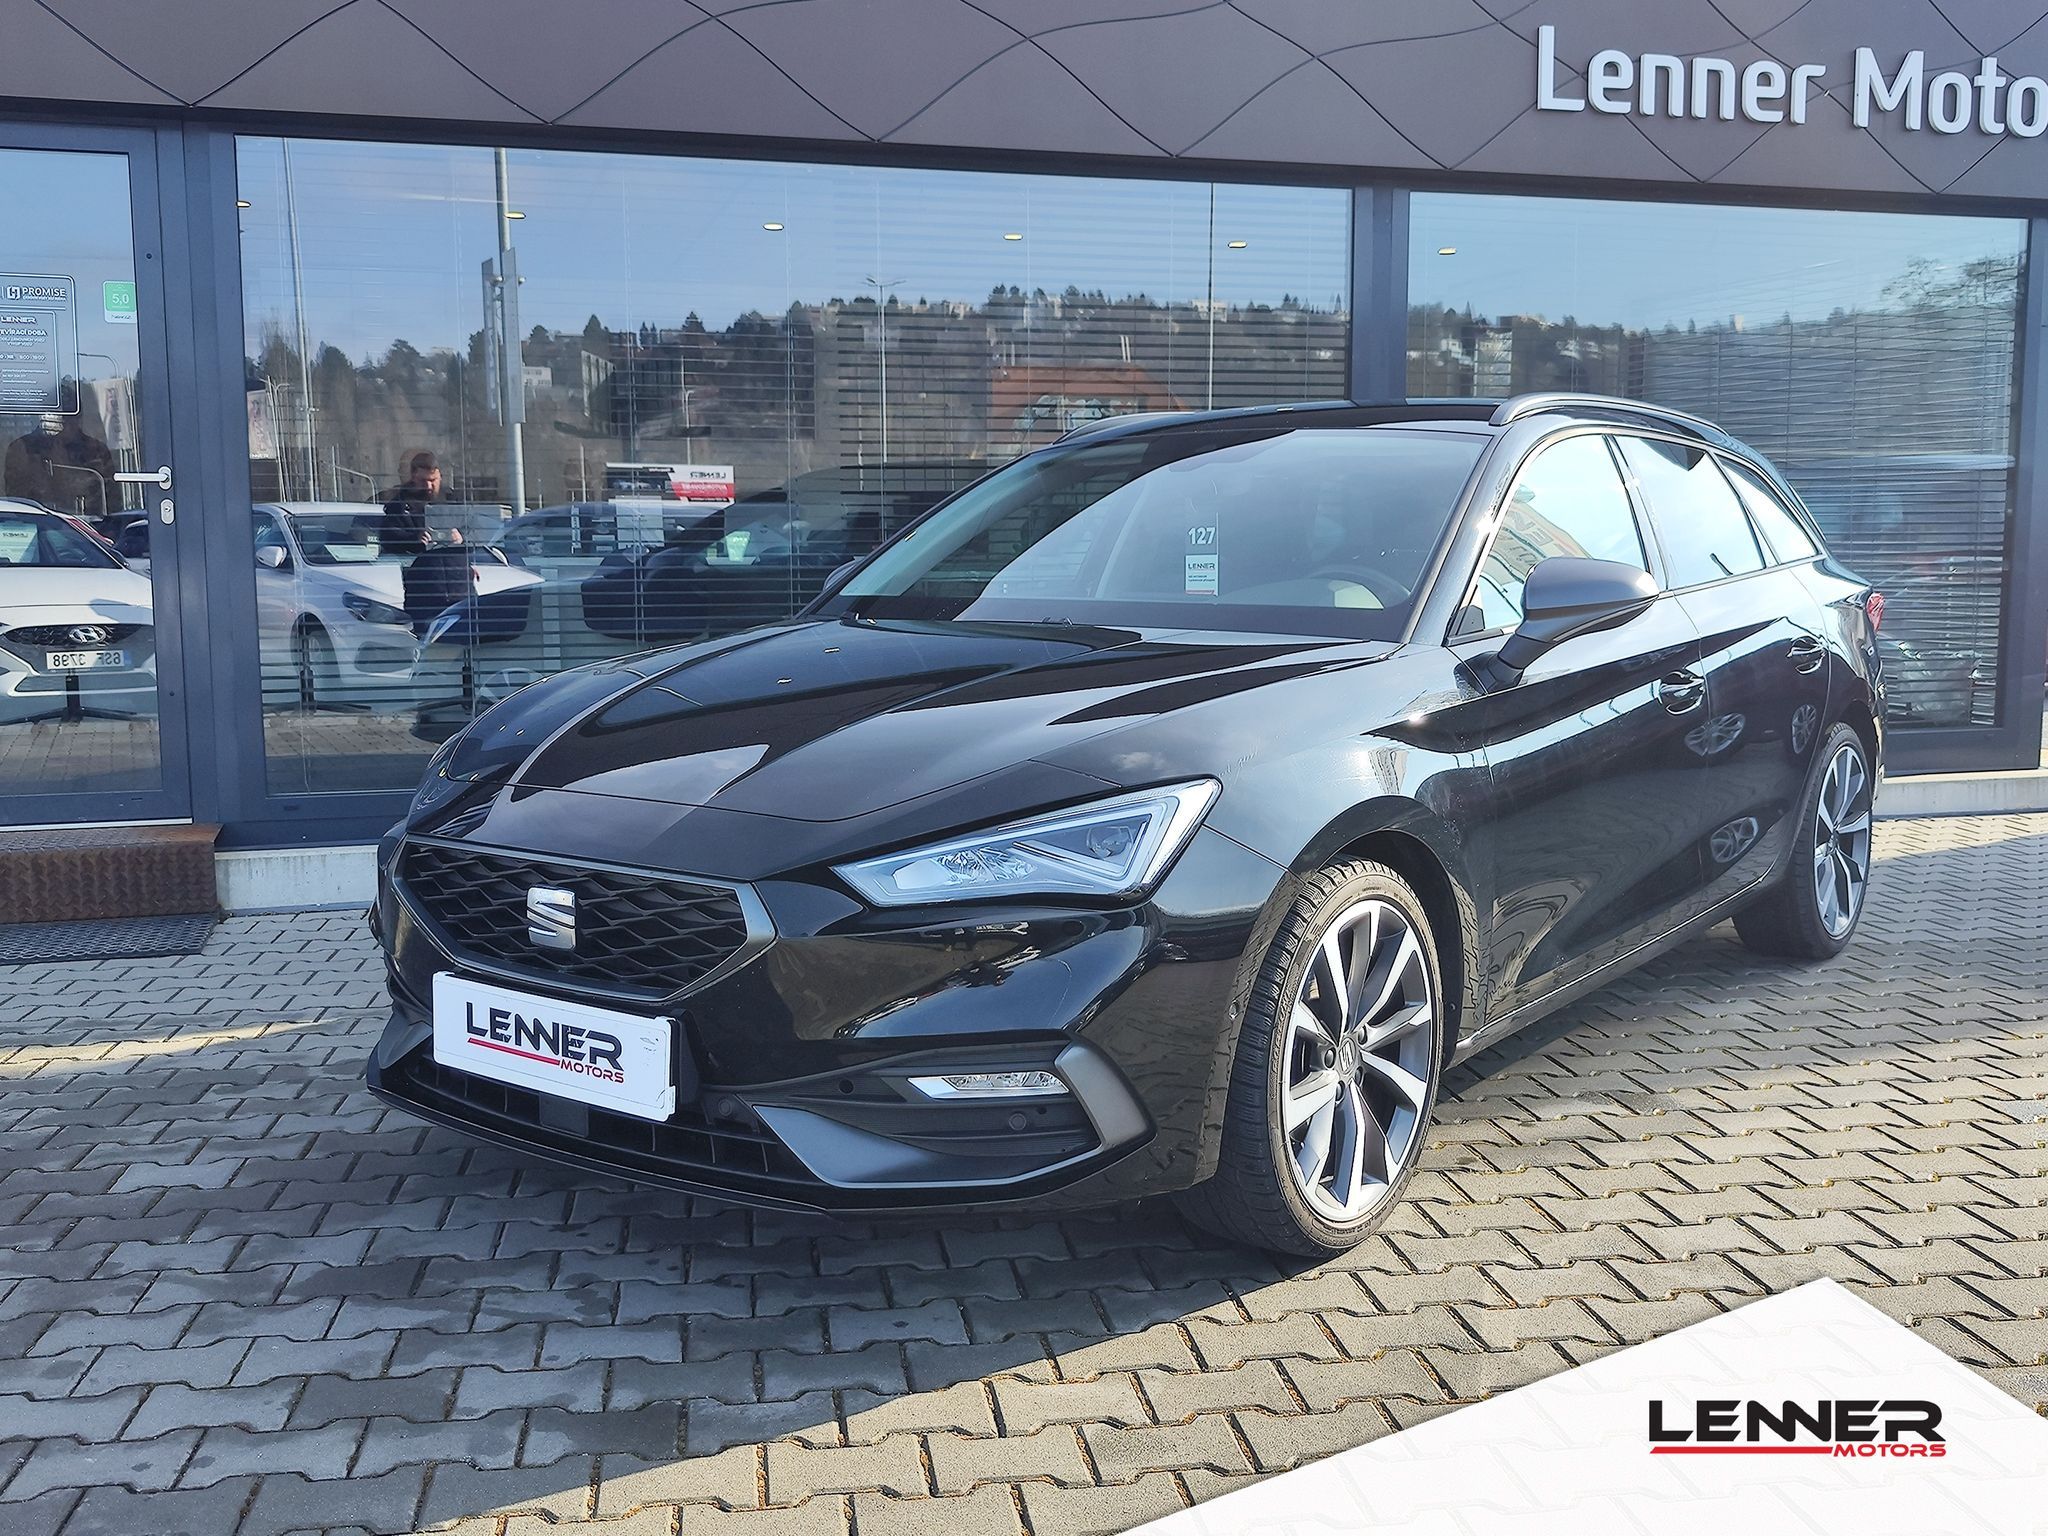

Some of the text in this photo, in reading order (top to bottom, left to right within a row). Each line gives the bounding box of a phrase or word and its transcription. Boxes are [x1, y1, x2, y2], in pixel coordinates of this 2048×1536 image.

[1537, 25, 2048, 139] Lenner Moto
[22, 286, 66, 297] PROMISE
[1, 316, 36, 324] LENNER
[1188, 526, 1216, 545] 127
[466, 1001, 624, 1072] LENNER
[560, 1058, 625, 1084] MOTORS
